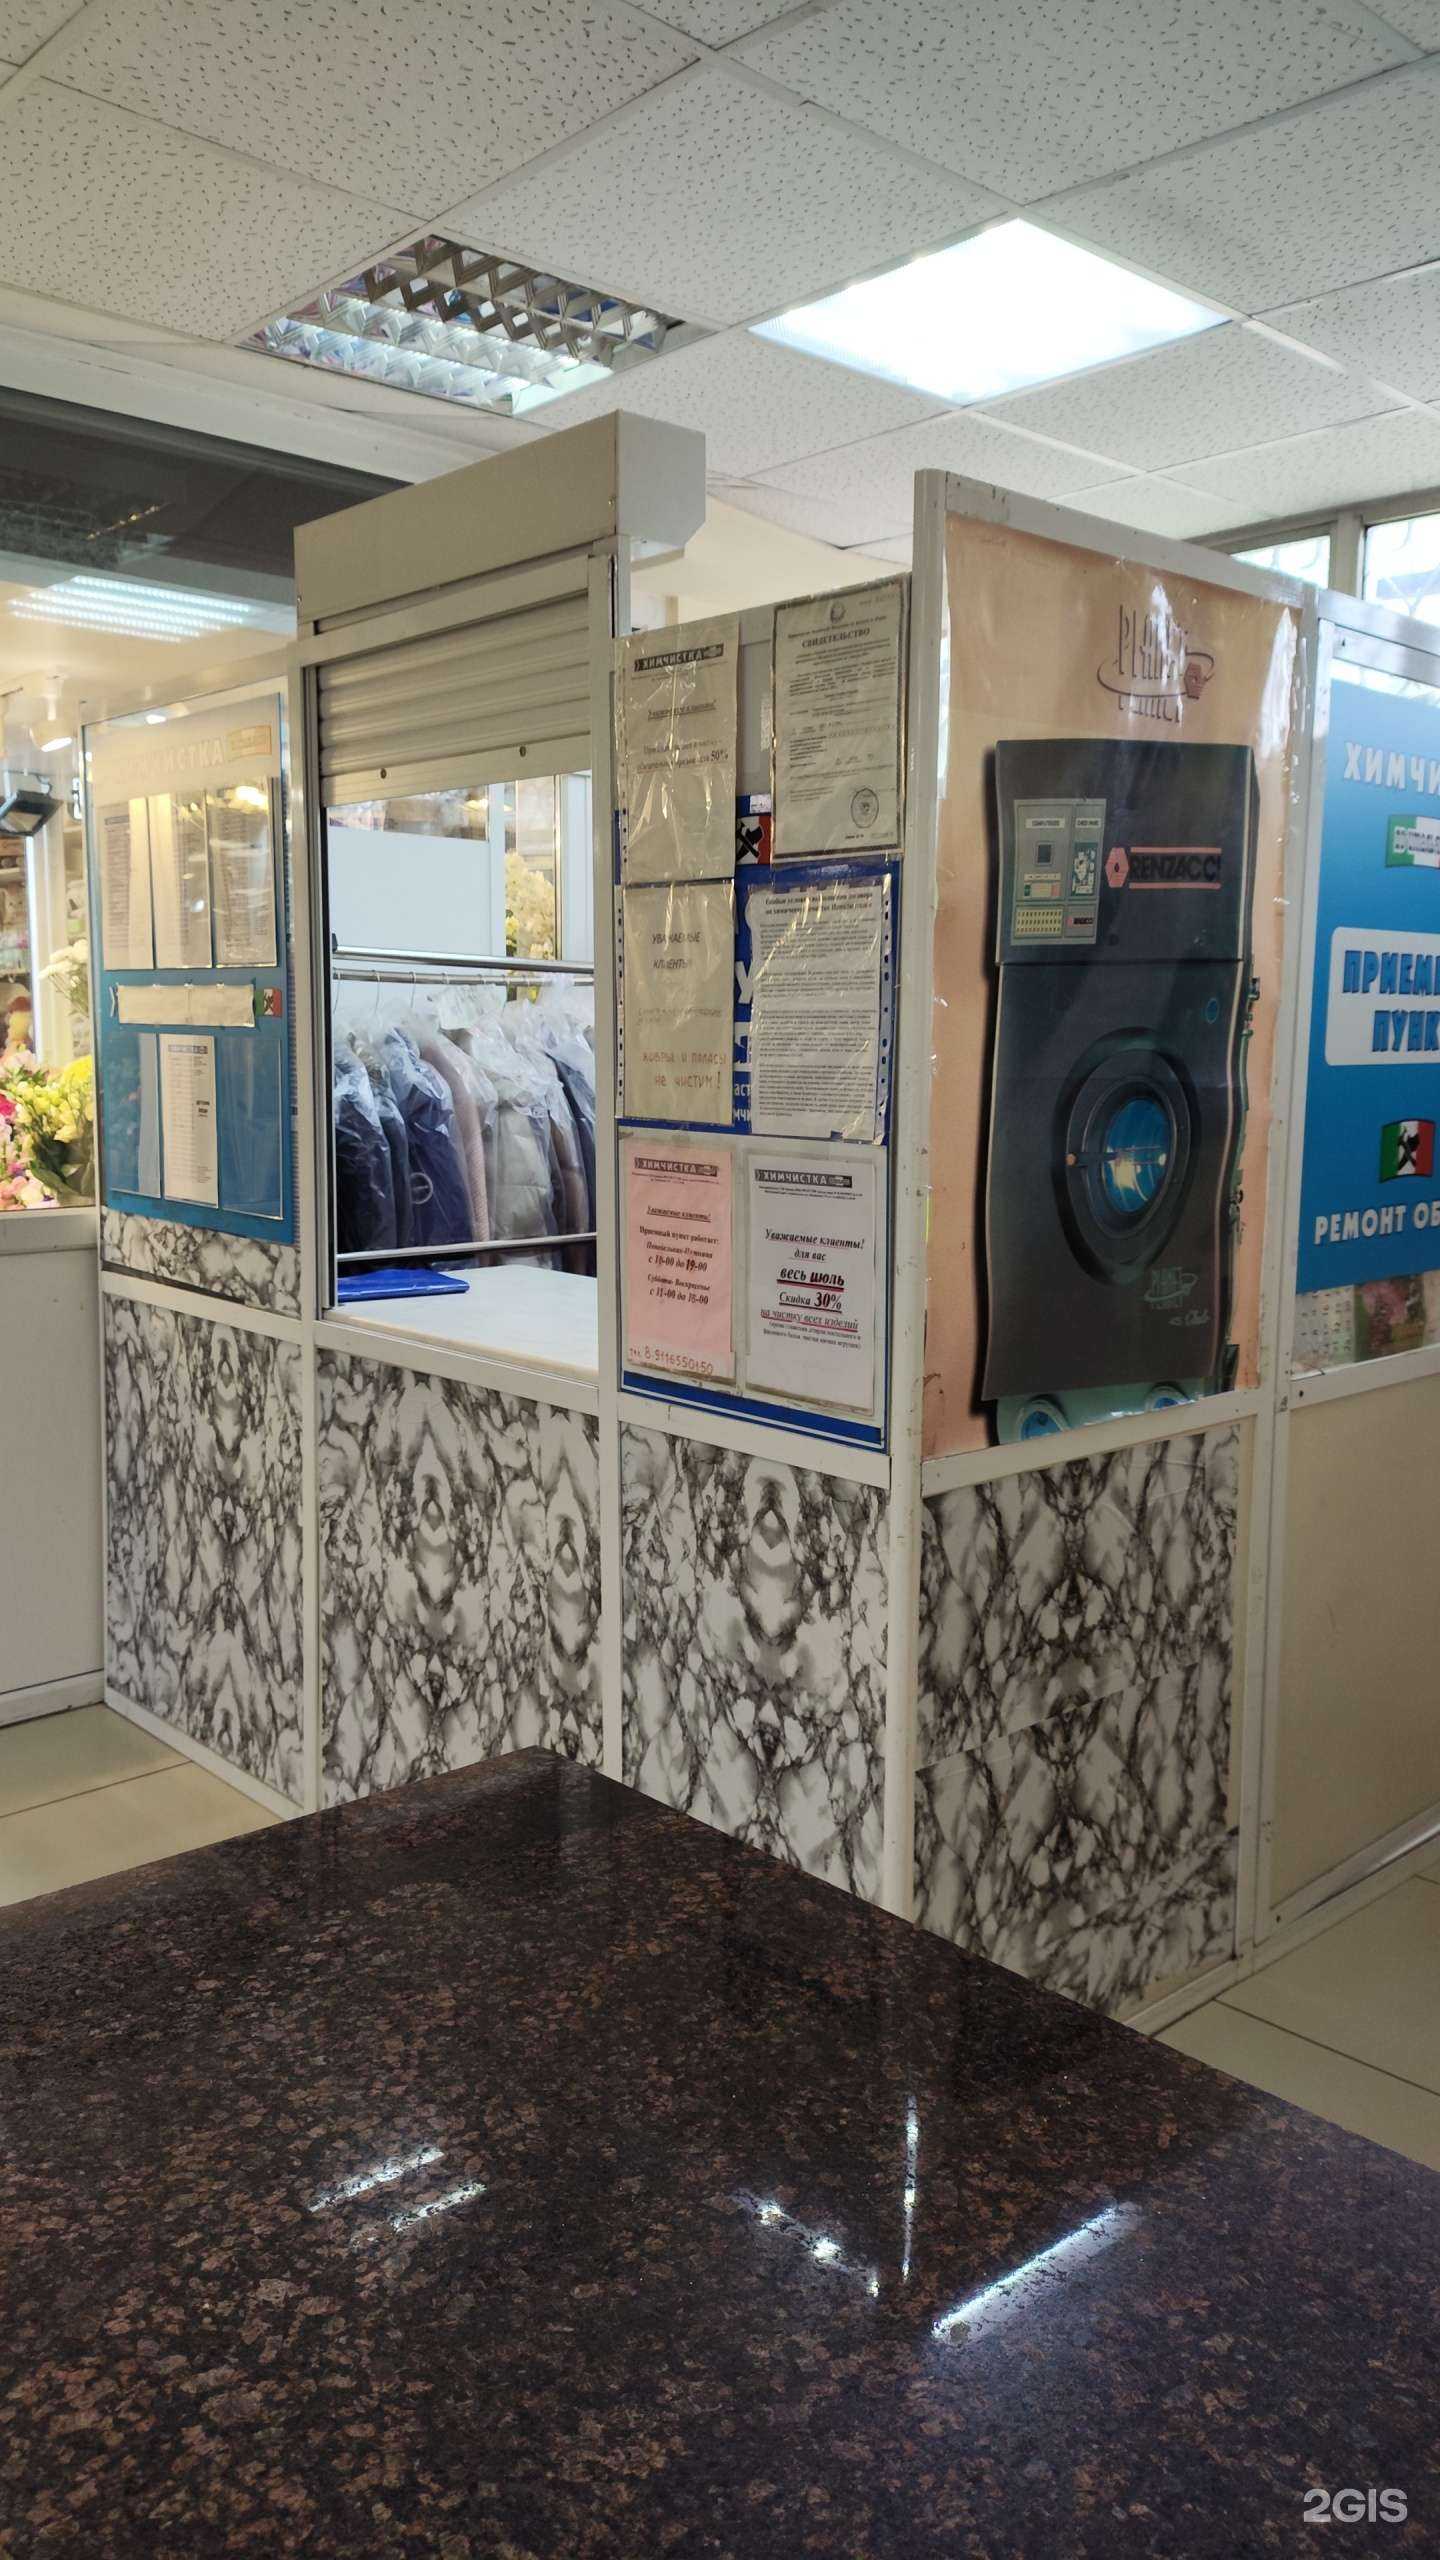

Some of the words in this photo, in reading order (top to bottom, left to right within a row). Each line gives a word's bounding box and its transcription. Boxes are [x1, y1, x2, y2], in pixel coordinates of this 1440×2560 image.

[642, 649, 703, 669] ХИМЧИСТКА
[1343, 741, 1440, 796] ХИМЧИ
[1130, 855, 1221, 881] RENZACCI
[1372, 1010, 1440, 1053] ПУНК
[642, 1158, 697, 1174] ХИМЧИСТКА
[763, 1171, 828, 1185] ХИМЧИСТКА
[1313, 1205, 1406, 1245] РЕМОНТ
[765, 1228, 818, 1245] Уважаемые
[819, 1236, 865, 1250] клиенты!
[794, 1248, 810, 1260] для
[812, 1252, 827, 1262] вас
[780, 1267, 807, 1281] весь
[779, 1291, 811, 1306] Скидка
[814, 1292, 842, 1310] 30%
[773, 1311, 803, 1322] чистку
[803, 1315, 823, 1325] всех
[824, 1317, 859, 1331] изделий
[645, 1345, 651, 1360] 8
